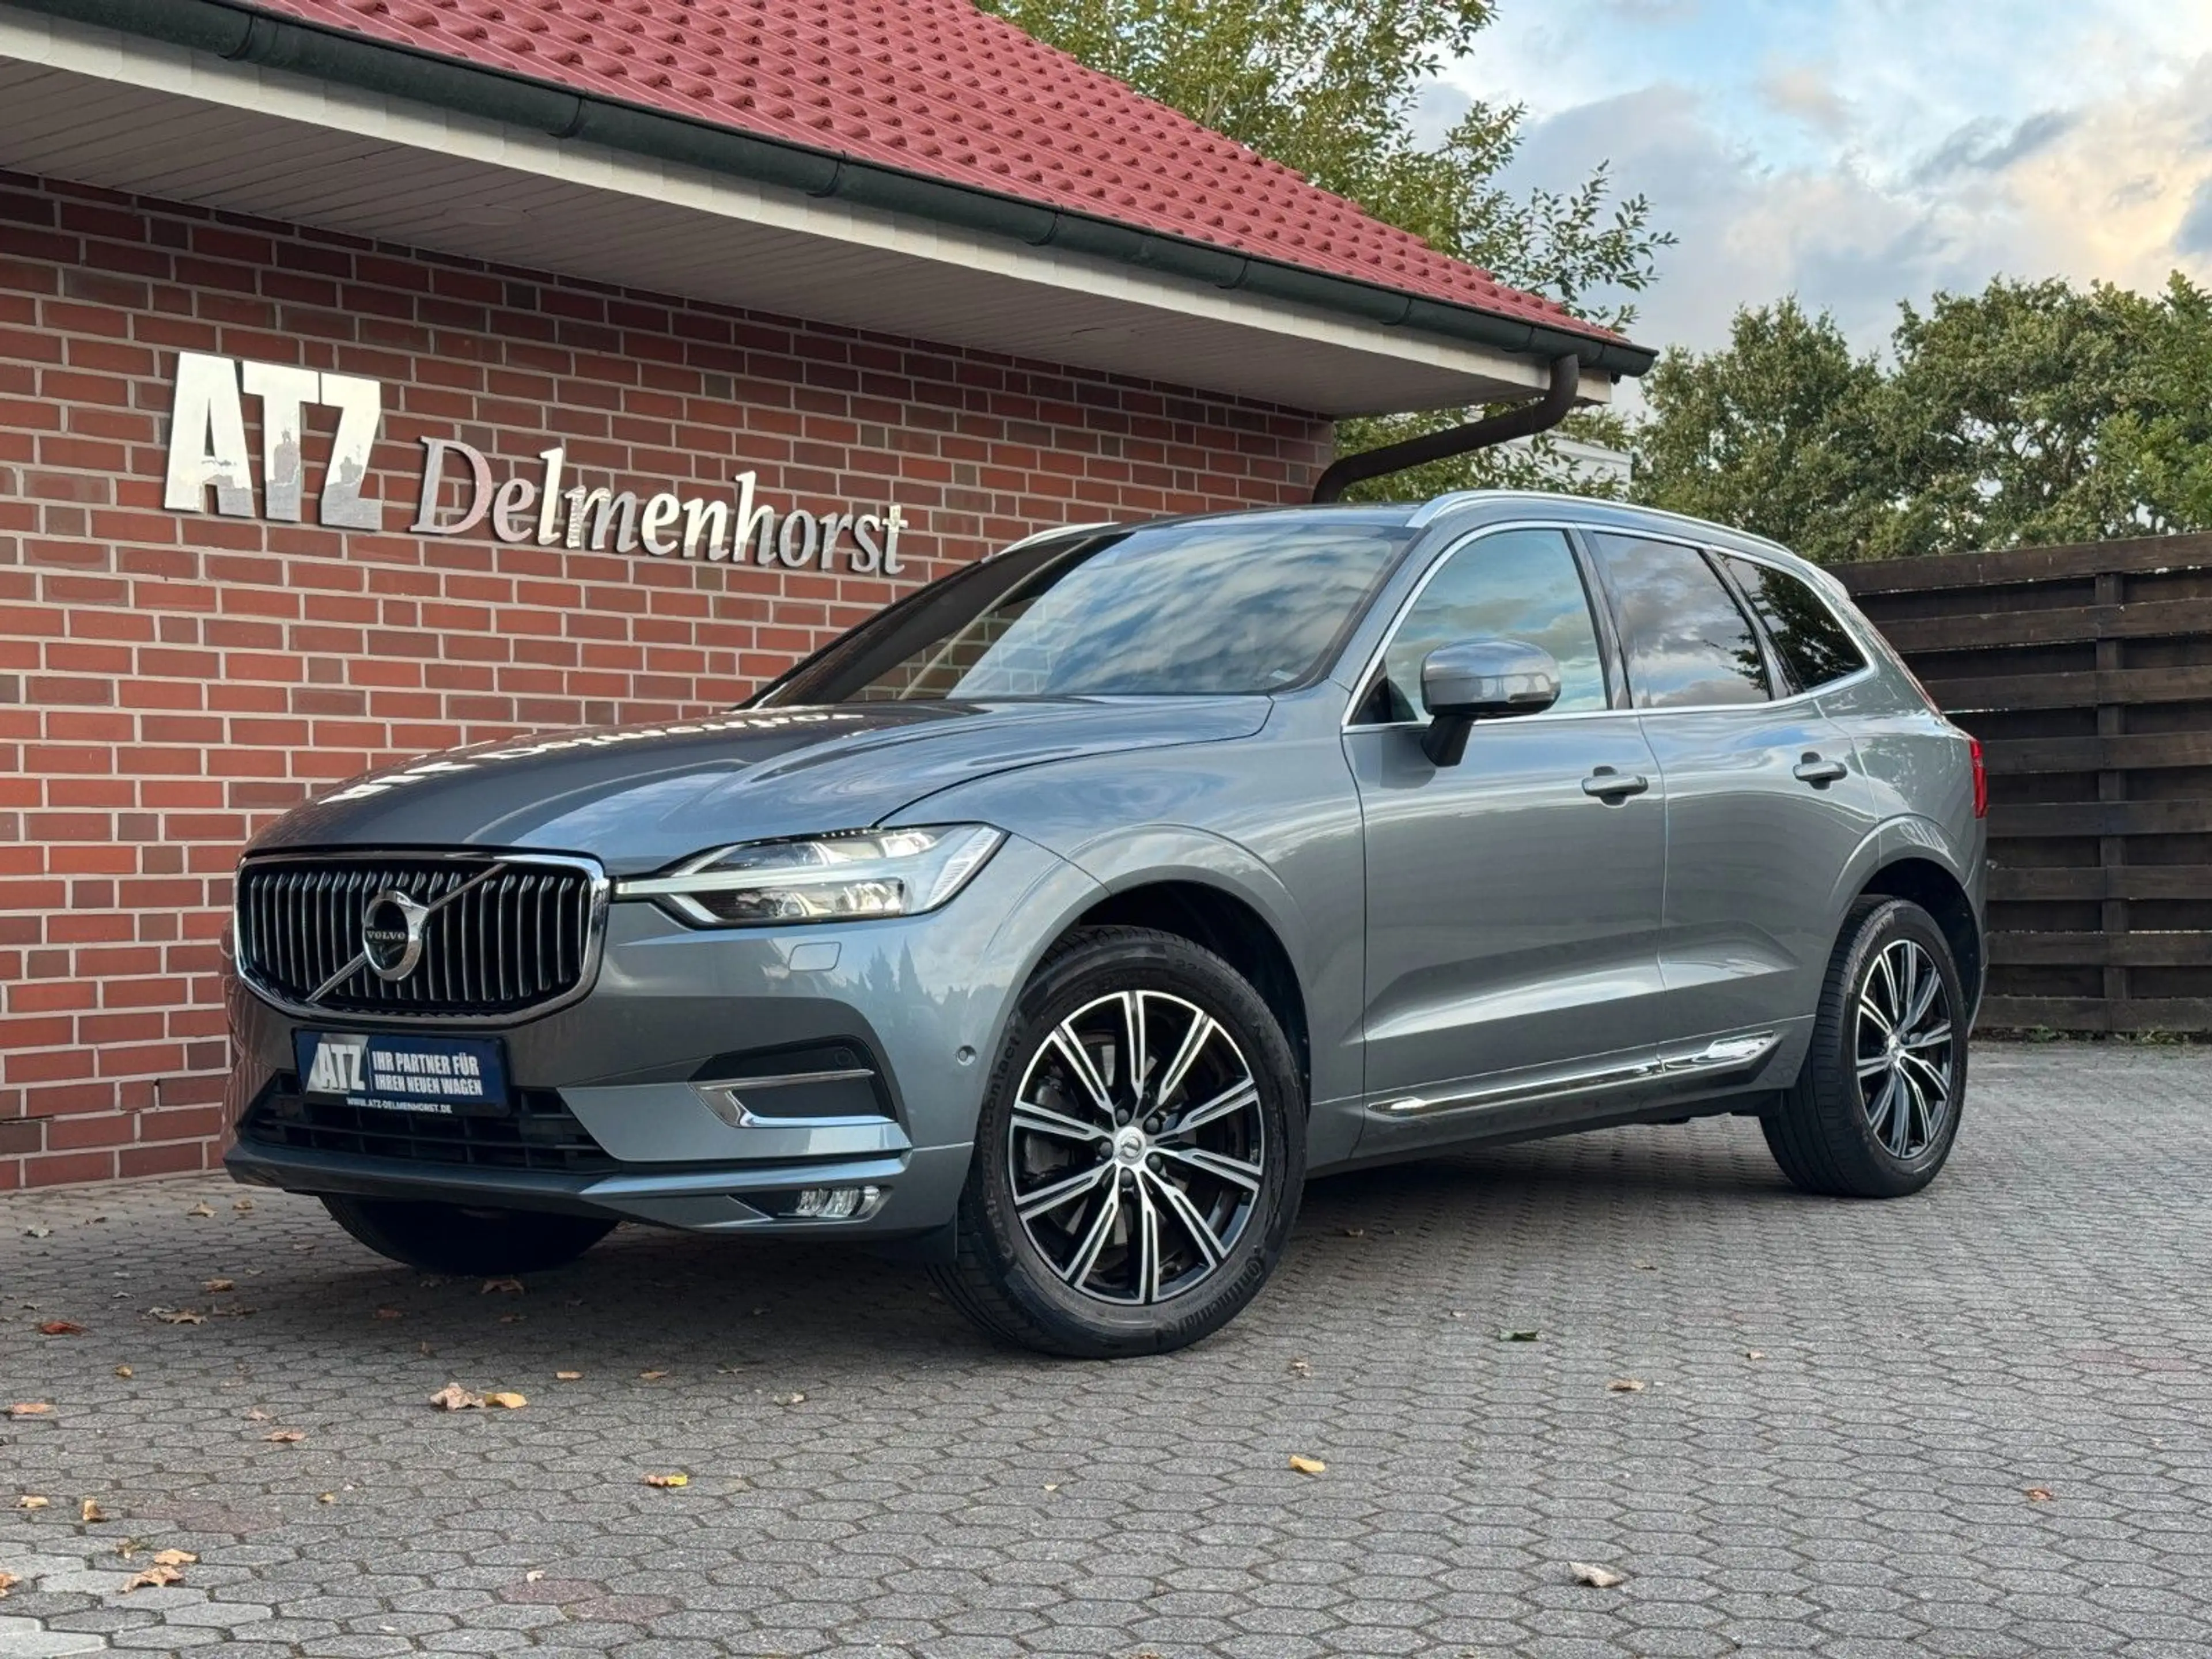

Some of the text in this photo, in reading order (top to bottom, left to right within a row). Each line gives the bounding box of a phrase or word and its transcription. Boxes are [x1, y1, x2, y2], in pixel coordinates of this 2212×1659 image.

[164, 351, 908, 574] ATZ Delmenhorst
[366, 931, 406, 940] VOLVO
[316, 1043, 366, 1090] ATZ
[372, 1051, 480, 1076] IHR PARTNER FÜR
[374, 1074, 483, 1096] IHREN NEUEN WAGEN
